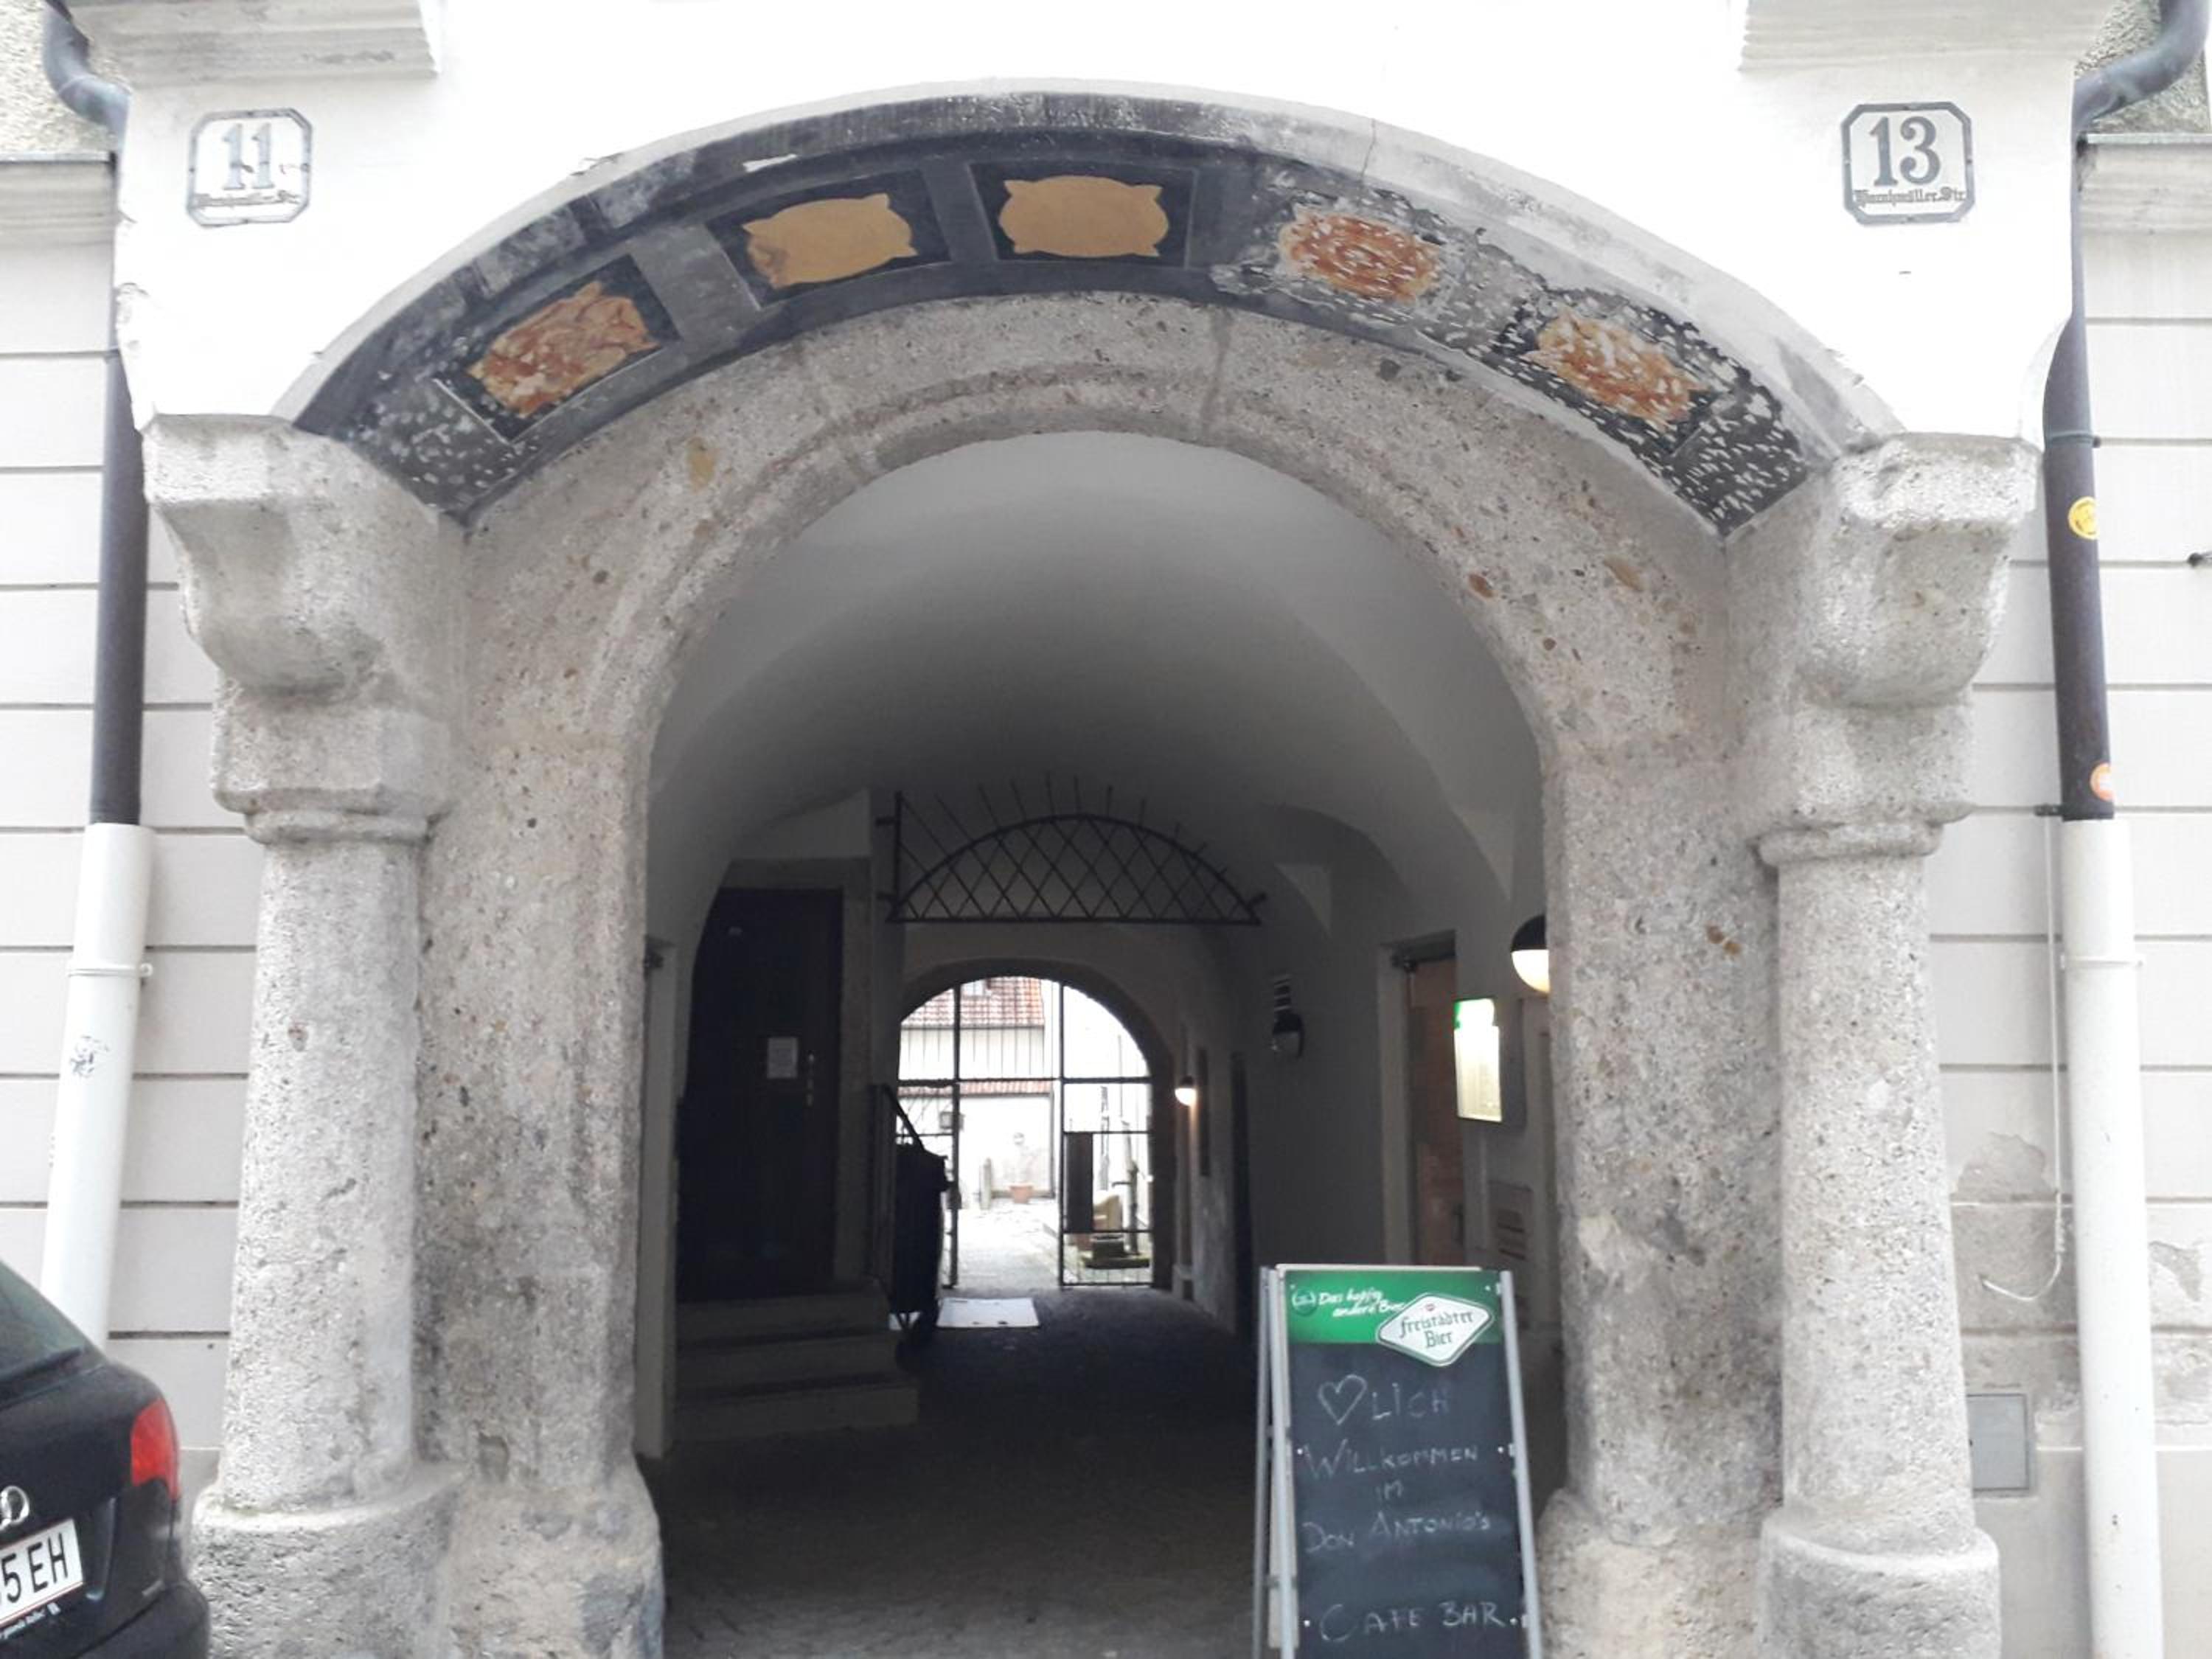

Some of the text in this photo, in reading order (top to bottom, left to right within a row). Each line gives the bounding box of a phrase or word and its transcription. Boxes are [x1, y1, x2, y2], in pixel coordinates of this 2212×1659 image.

[221, 122, 275, 190] 11
[1868, 115, 1941, 187] 13
[1424, 1330, 1453, 1348] Bier
[1439, 1601, 1506, 1627] BAR
